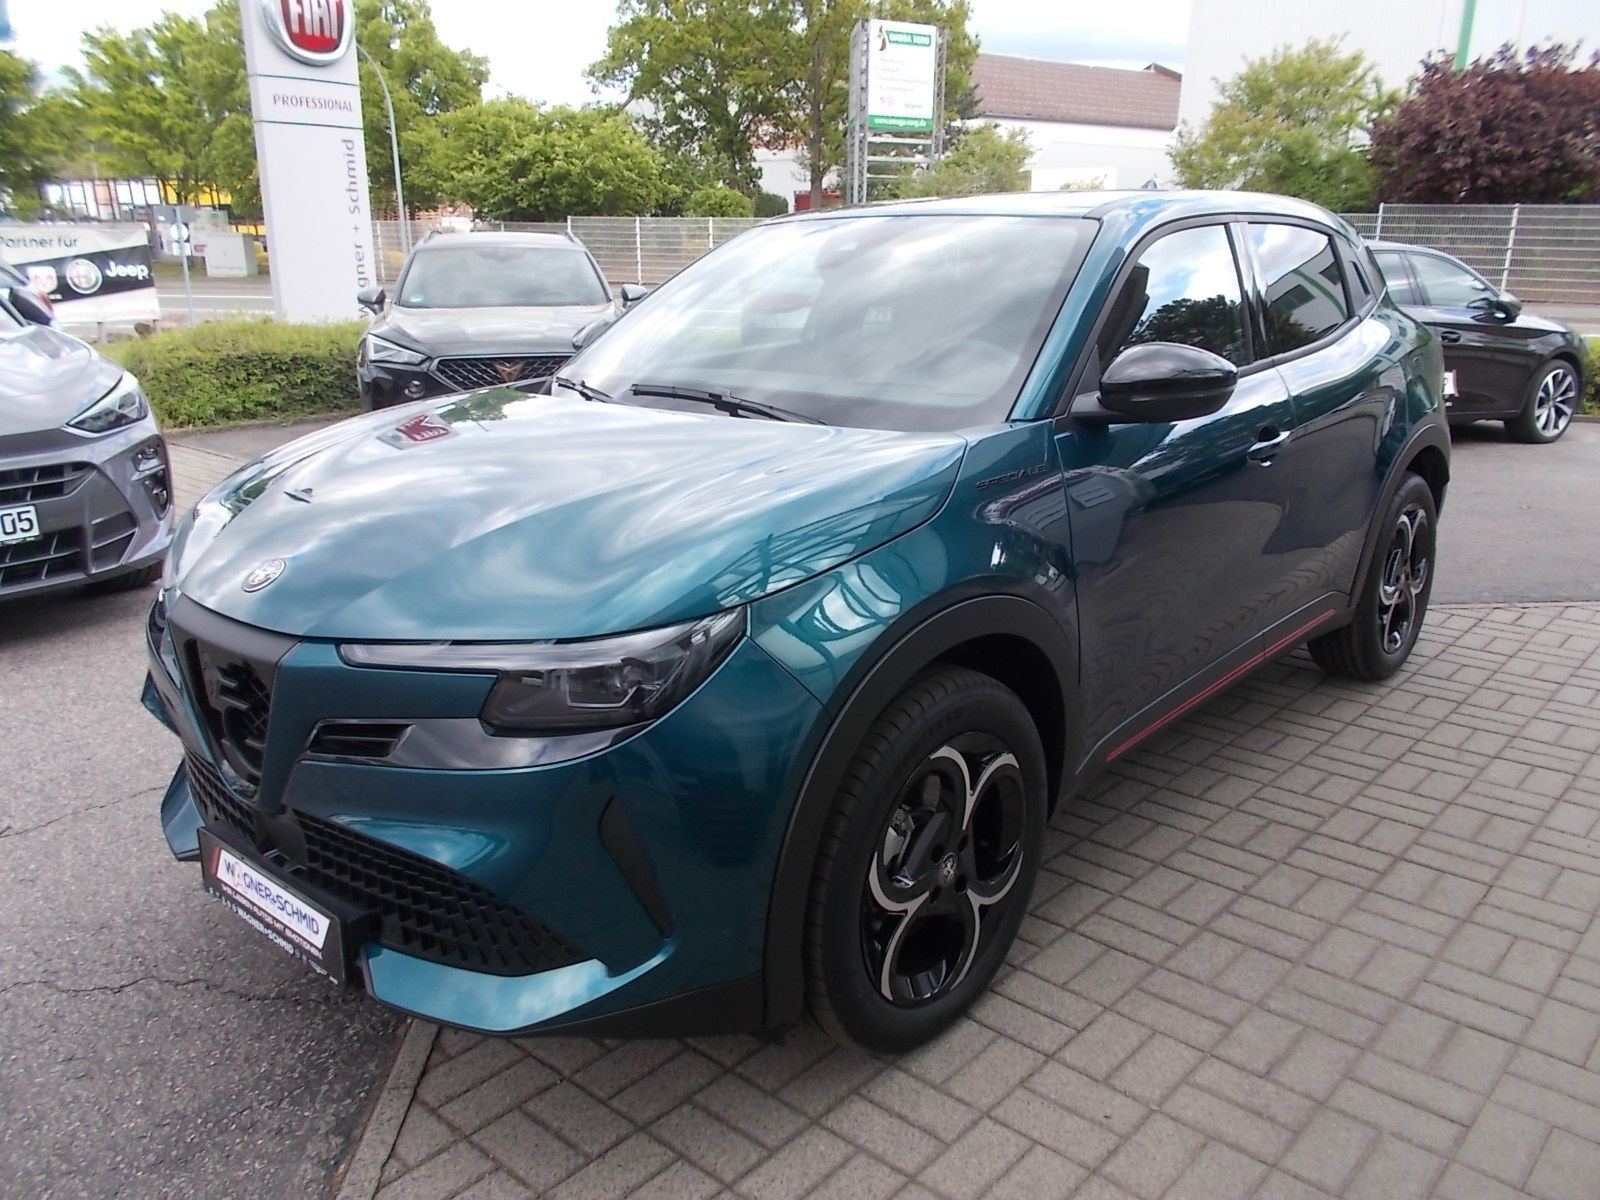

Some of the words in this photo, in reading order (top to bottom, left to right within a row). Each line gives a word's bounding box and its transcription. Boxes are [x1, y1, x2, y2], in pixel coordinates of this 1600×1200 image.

[288, 0, 341, 39] FIAT
[273, 94, 353, 112] PROFESSIONAL
[341, 139, 361, 214] Schmid
[105, 260, 149, 281] Jeep
[355, 243, 371, 317] wgner
[0, 509, 34, 535] 05
